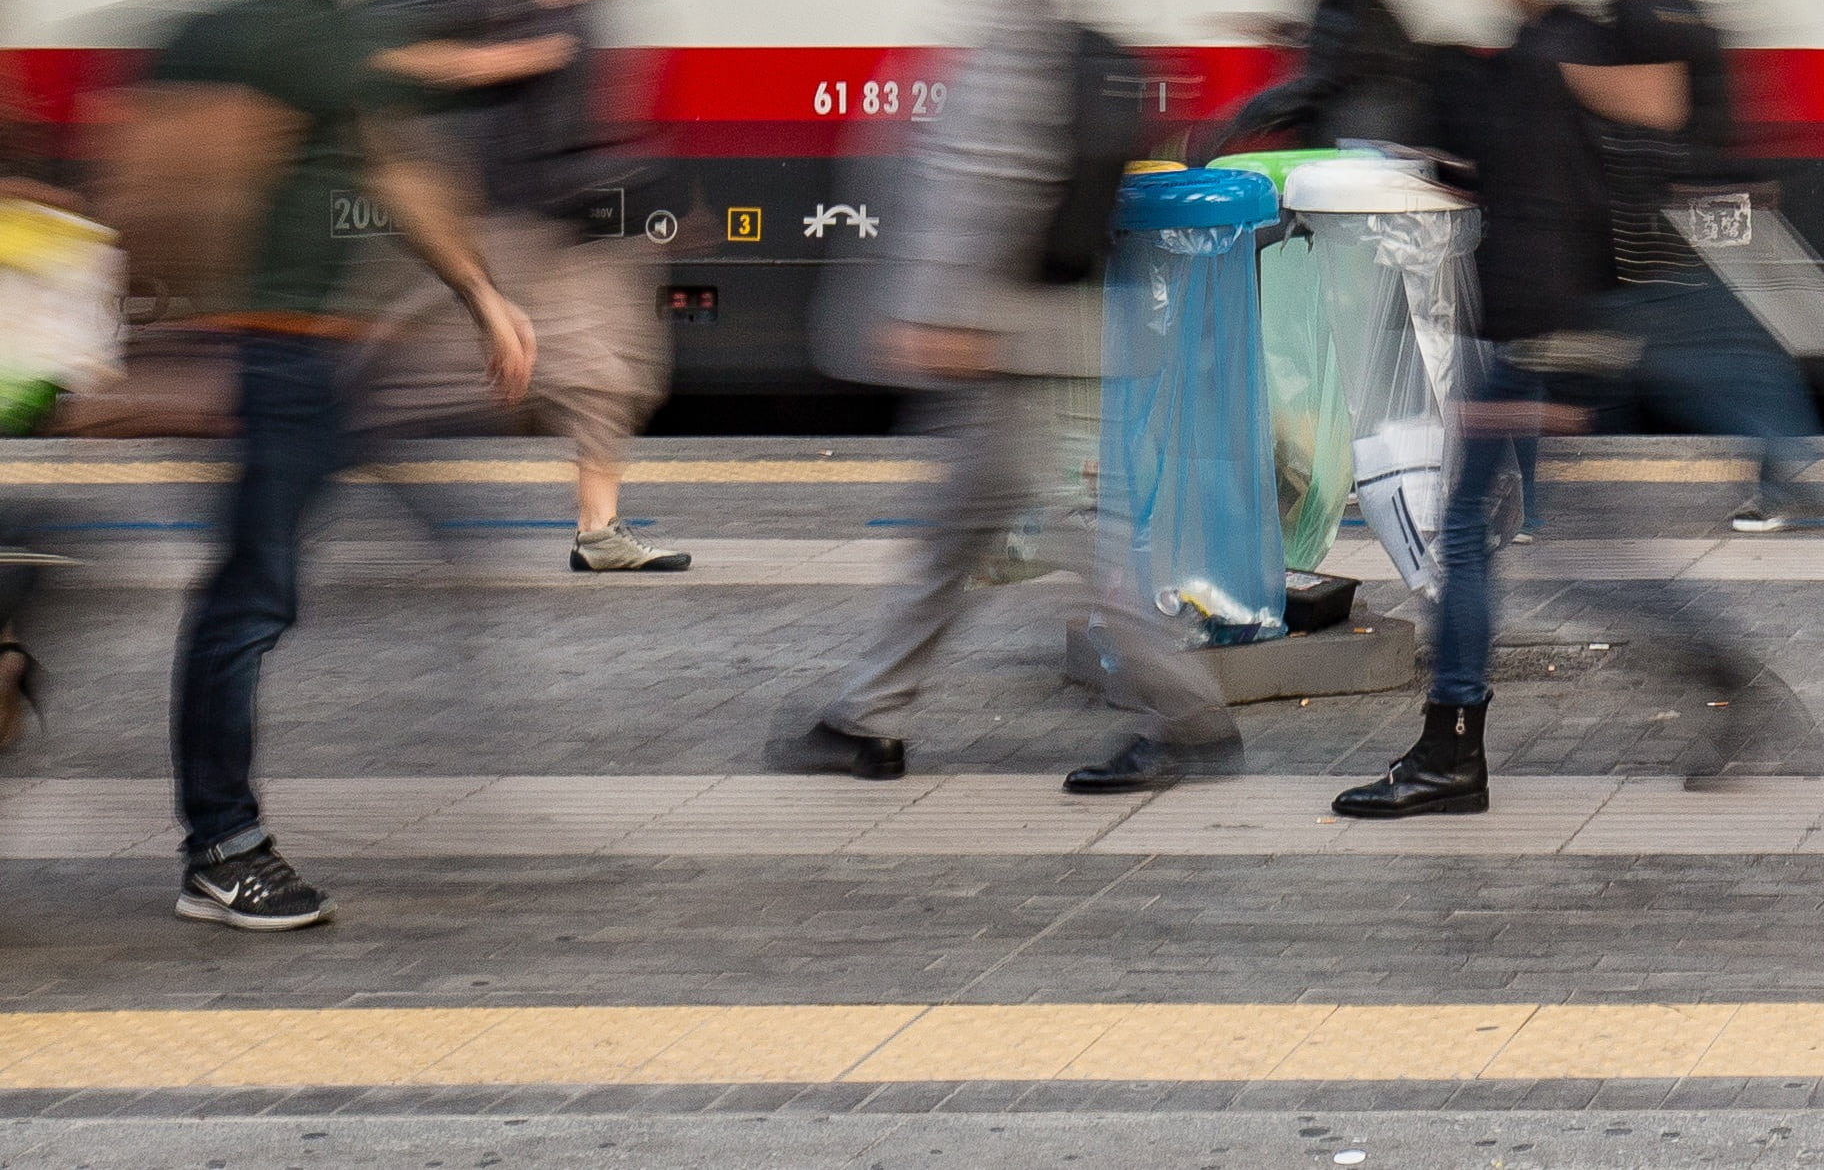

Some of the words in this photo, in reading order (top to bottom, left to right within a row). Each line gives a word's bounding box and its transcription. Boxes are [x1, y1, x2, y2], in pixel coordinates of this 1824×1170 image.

[813, 81, 848, 115] 61
[862, 81, 899, 115] 83
[911, 82, 948, 116] 29
[738, 213, 751, 235] 3
